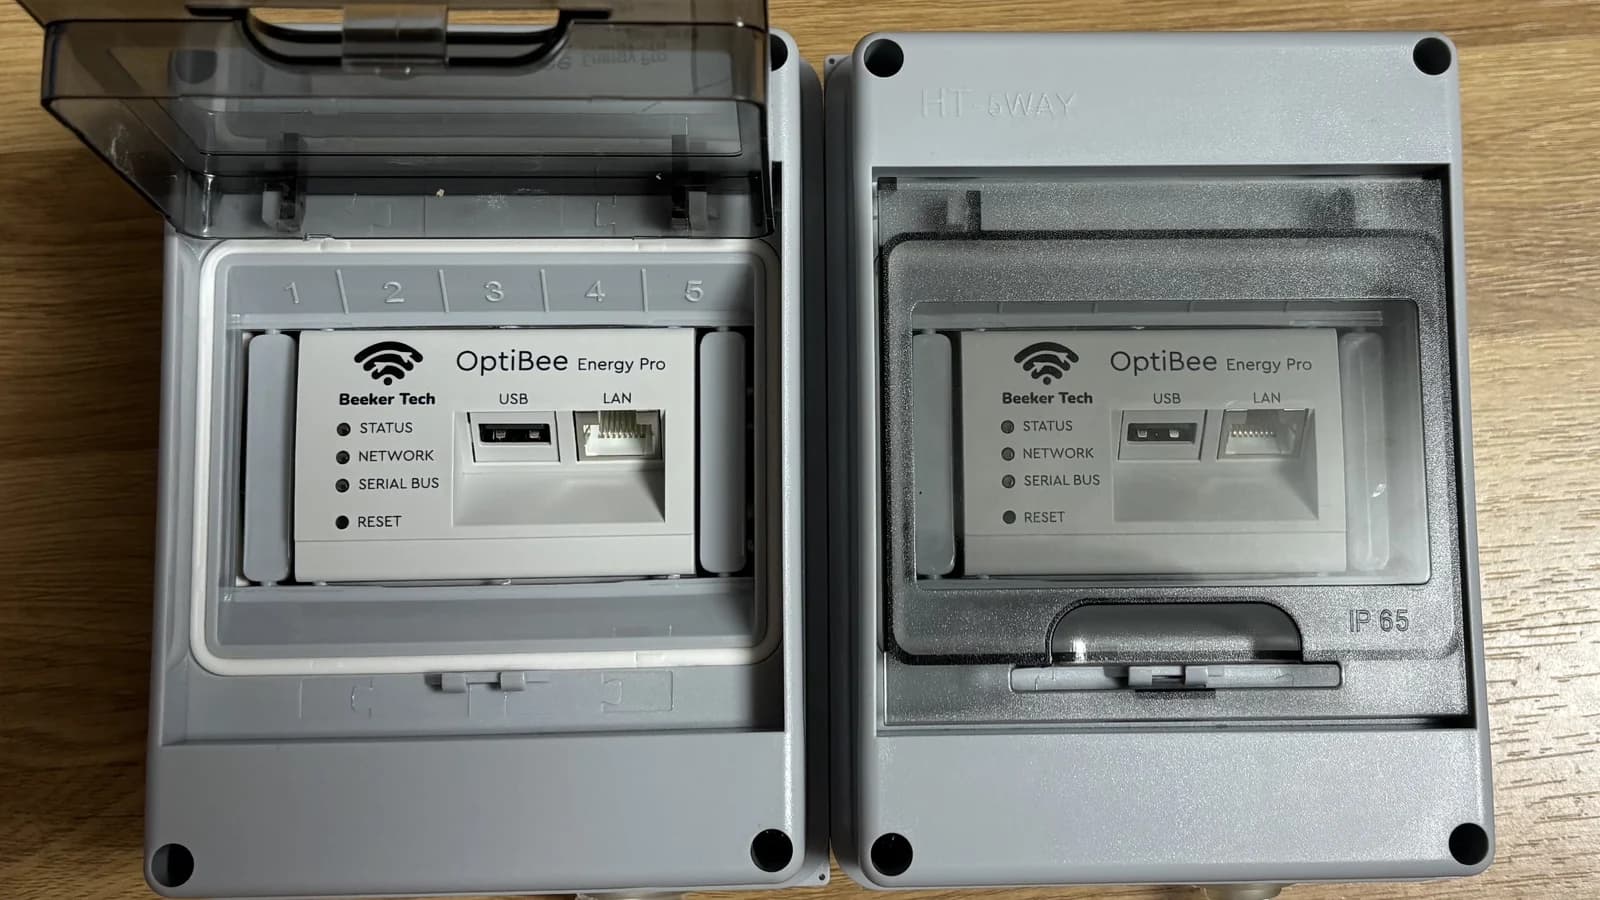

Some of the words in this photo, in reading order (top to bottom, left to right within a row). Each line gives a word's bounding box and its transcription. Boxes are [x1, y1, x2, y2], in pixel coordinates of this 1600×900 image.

[286, 281, 299, 303] 1
[383, 281, 405, 303] 2
[484, 280, 504, 302] 3
[584, 280, 606, 302] 4
[684, 280, 704, 302] 5
[456, 349, 569, 377] OptiBee
[577, 358, 634, 374] Energy
[639, 357, 666, 371] Pro
[1110, 350, 1217, 377] OptiBee
[1226, 358, 1281, 374] Energy
[1286, 358, 1313, 371] Pro
[338, 392, 395, 406] Beeker
[399, 392, 436, 406] Tech
[499, 393, 529, 405] USB
[603, 392, 632, 404] LAN
[1002, 391, 1054, 405] Beeker
[1058, 391, 1093, 404] Tech
[1153, 393, 1182, 405] USB
[1253, 392, 1281, 404] LAN
[359, 421, 413, 434] STATUS
[1023, 420, 1073, 432] STATUS
[358, 449, 434, 462] NETWORK
[1023, 447, 1095, 460] NETWORK
[358, 477, 408, 490] SERIAL
[411, 477, 440, 489] BUS
[1023, 474, 1071, 487] SERIAL
[1073, 473, 1100, 486] BUS
[357, 515, 402, 528] RESET
[1024, 511, 1065, 524] RESET
[1349, 608, 1372, 633] IP
[1379, 608, 1410, 633] 65
